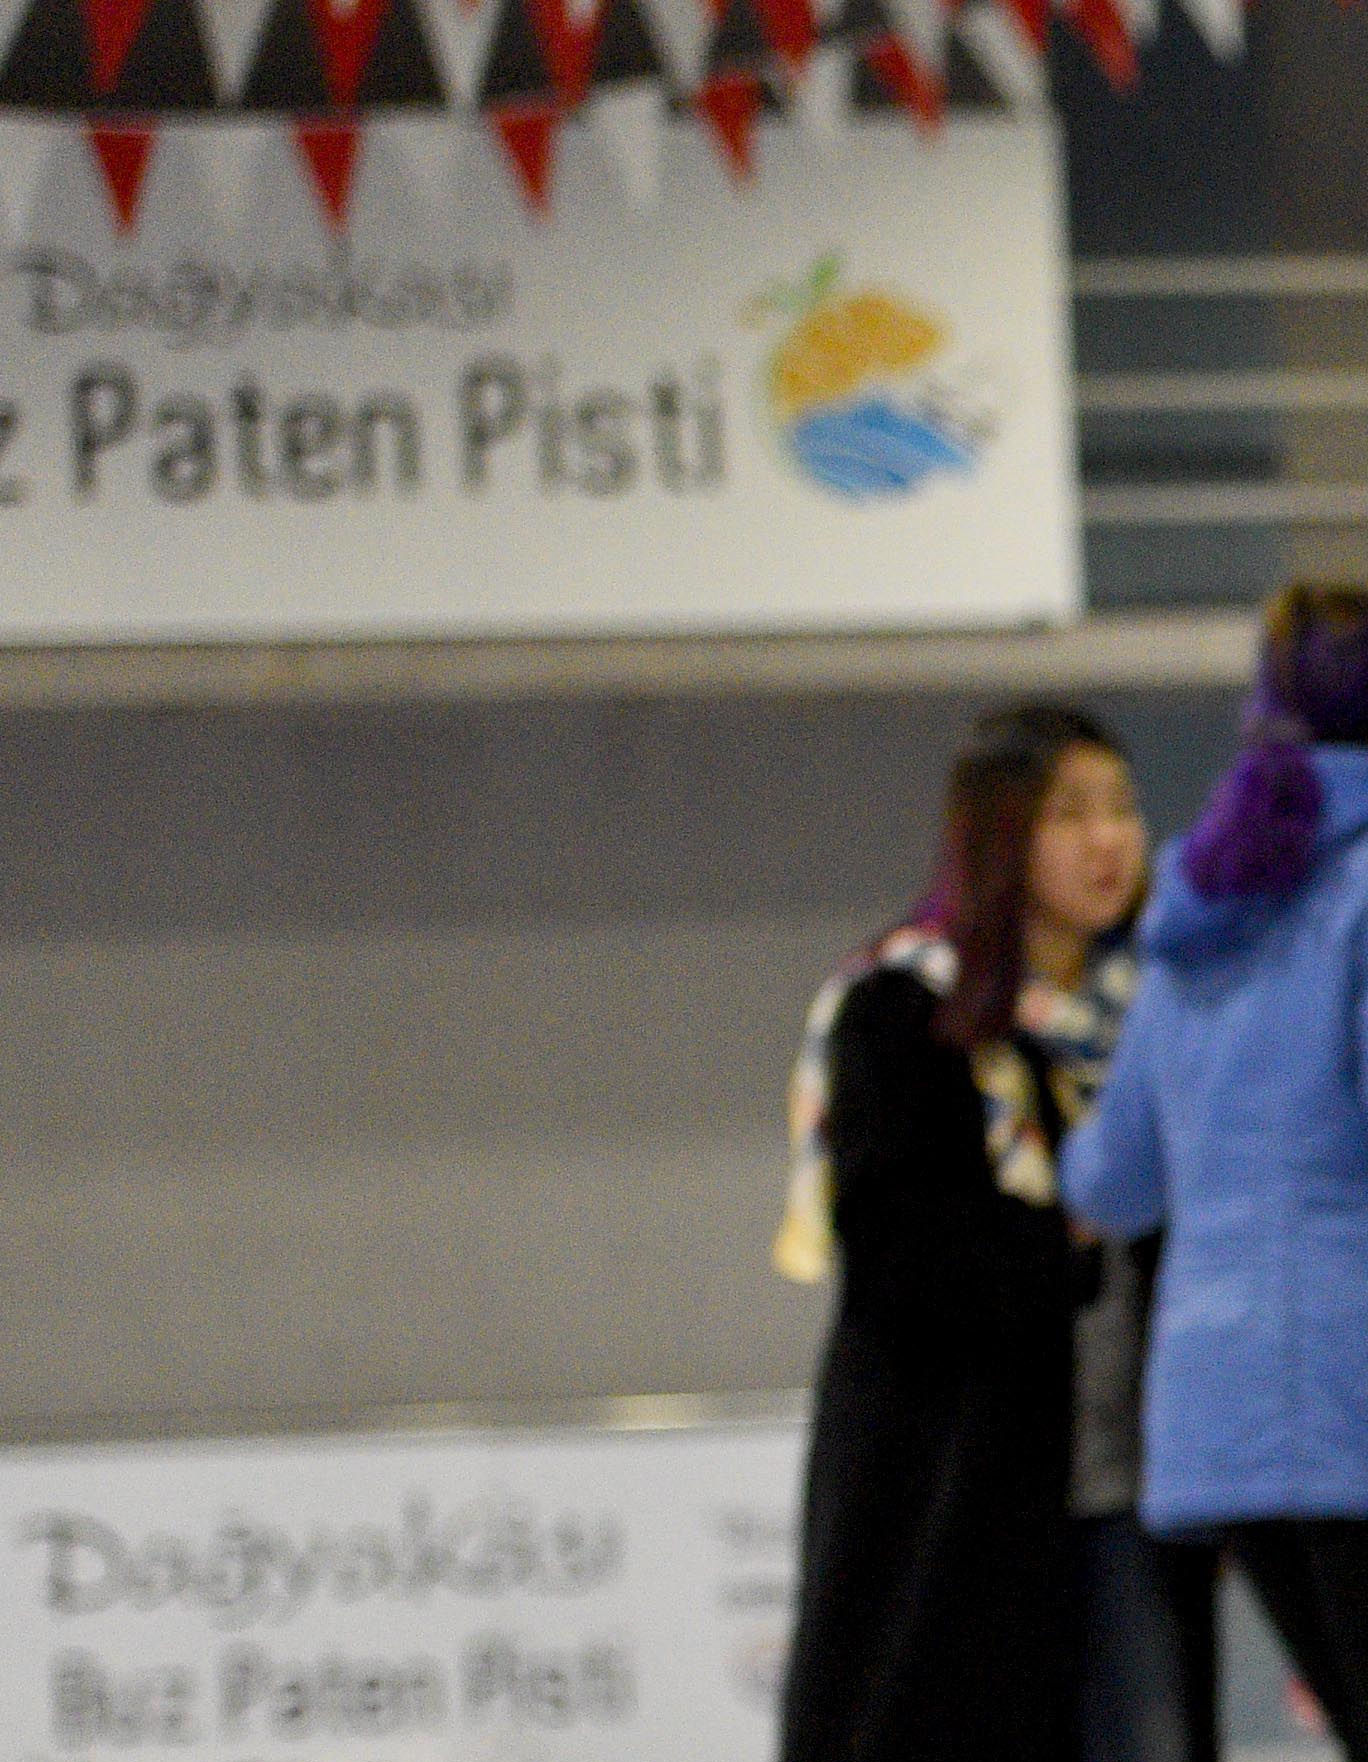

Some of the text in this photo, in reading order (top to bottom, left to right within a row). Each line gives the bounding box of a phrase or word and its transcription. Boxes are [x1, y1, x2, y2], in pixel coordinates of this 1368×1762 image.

[70, 358, 423, 503] Paten
[458, 352, 725, 500] Pisti
[217, 1637, 447, 1745] Paten
